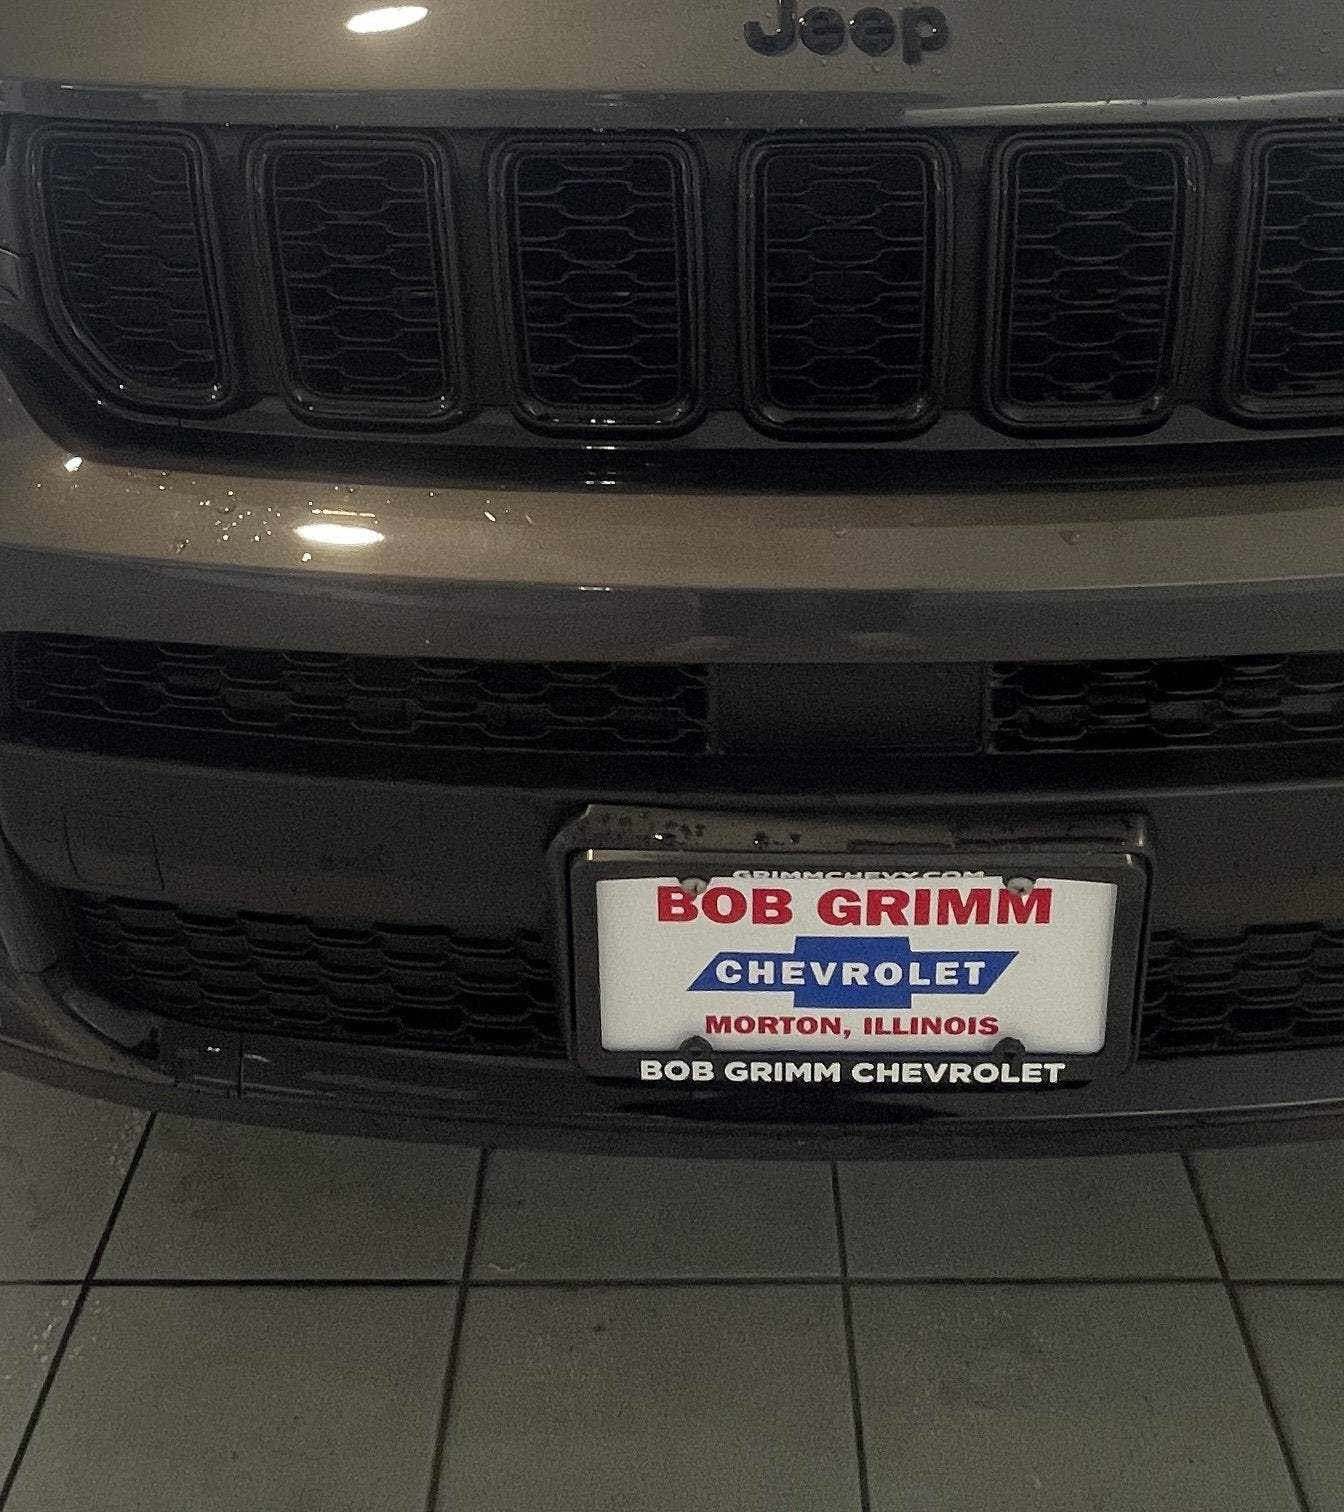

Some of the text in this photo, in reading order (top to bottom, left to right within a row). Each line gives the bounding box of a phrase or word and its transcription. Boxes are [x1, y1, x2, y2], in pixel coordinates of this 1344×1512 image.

[657, 887, 1052, 926] BOB GRIMM
[715, 959, 989, 986] CHEVROLET
[705, 1015, 999, 1039] MORTON, ILLINOIS
[640, 1059, 1066, 1084] BOB GRIMM CHEVROLET
